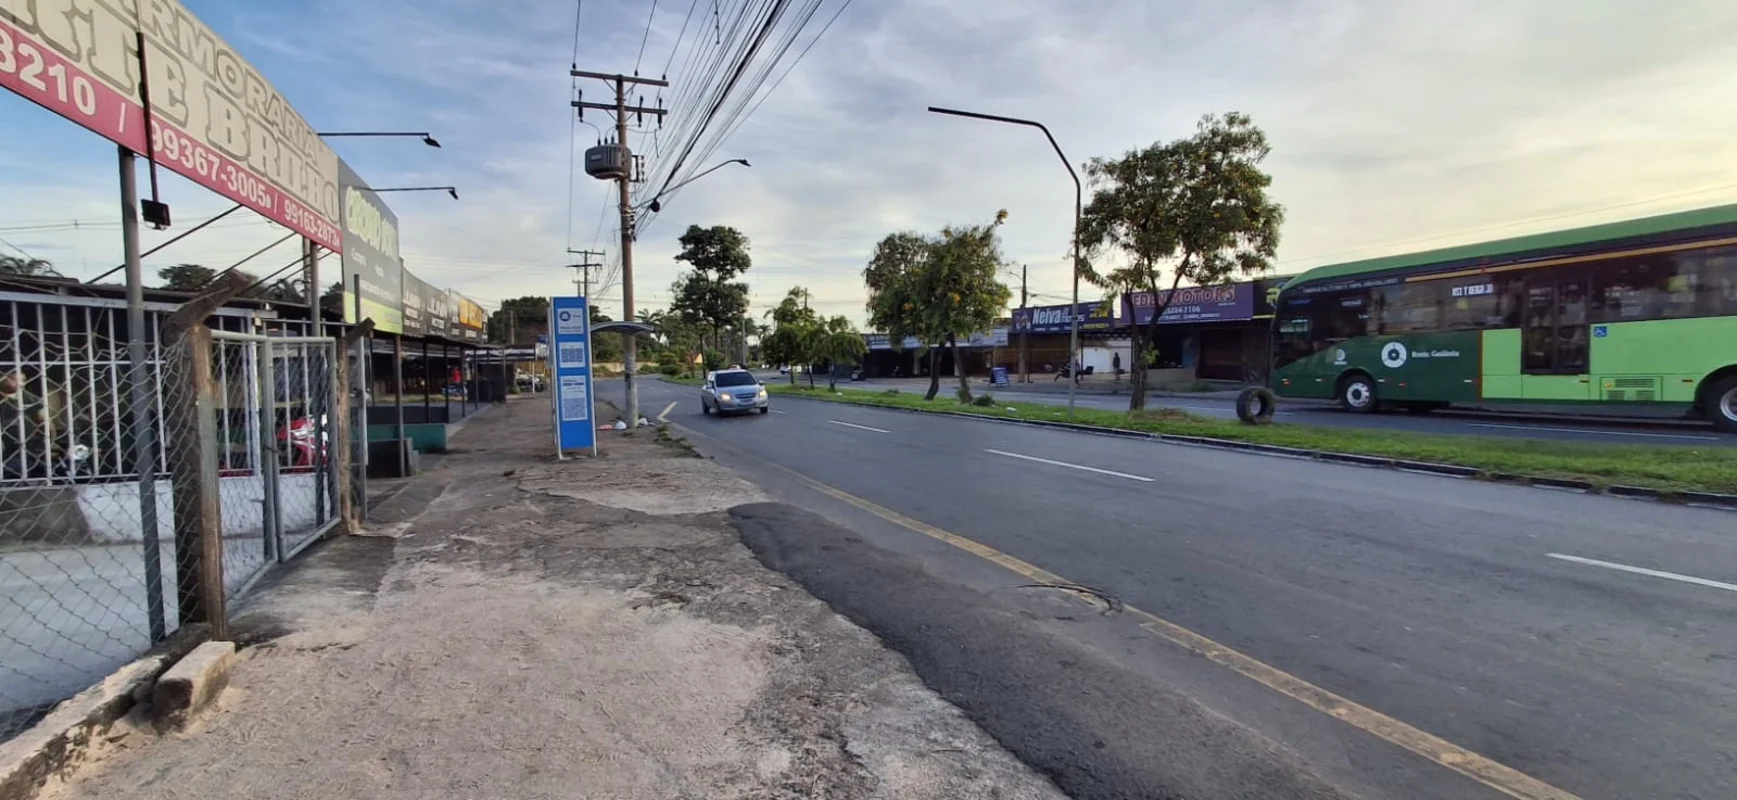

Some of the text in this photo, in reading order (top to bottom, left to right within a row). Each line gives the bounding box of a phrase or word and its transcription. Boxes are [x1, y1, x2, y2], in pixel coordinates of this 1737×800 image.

[120, 0, 321, 168] RMORARIA
[206, 80, 341, 223] BRILHO
[1032, 308, 1061, 325] Neiva
